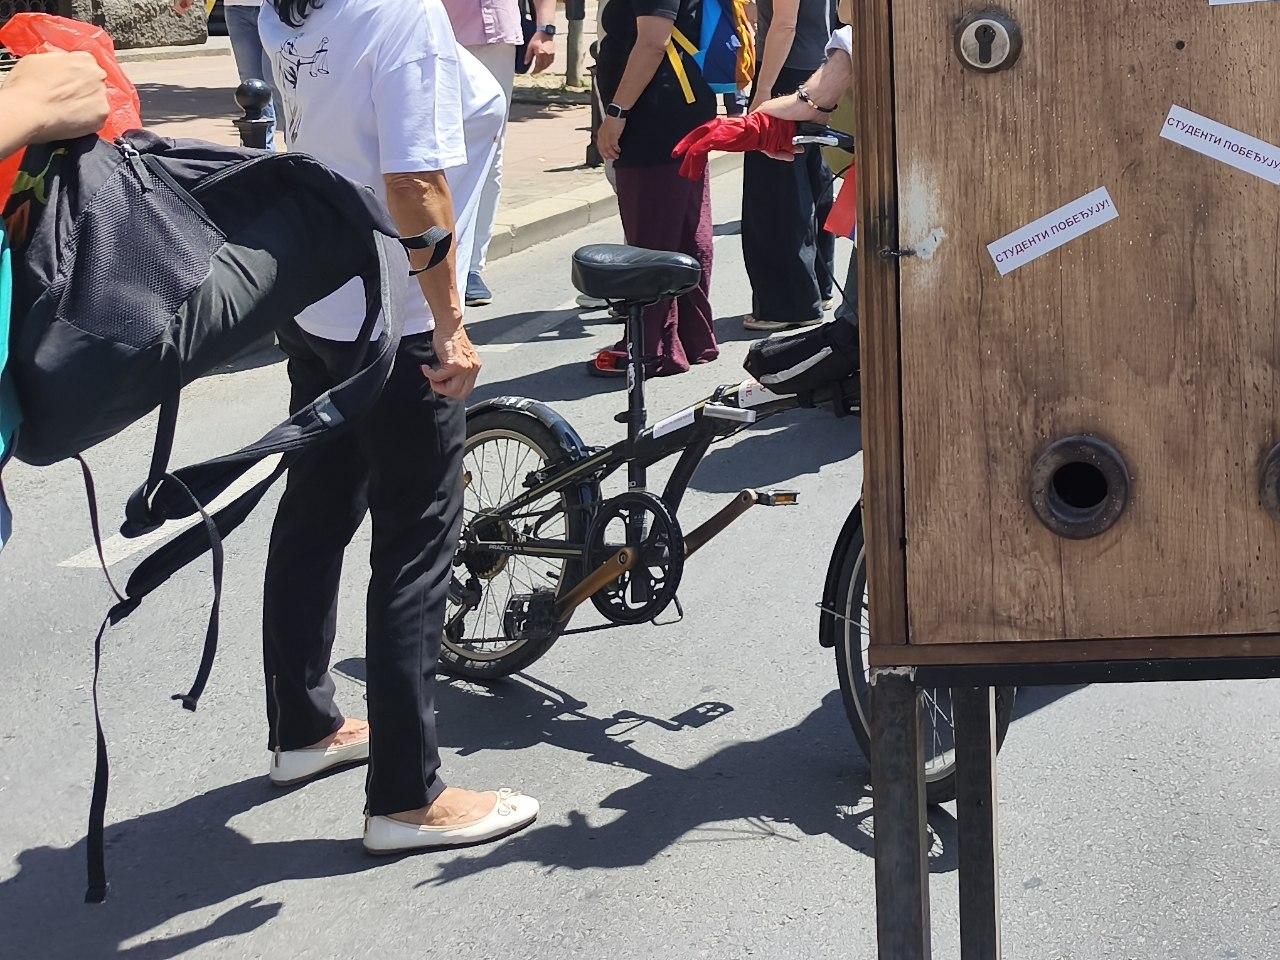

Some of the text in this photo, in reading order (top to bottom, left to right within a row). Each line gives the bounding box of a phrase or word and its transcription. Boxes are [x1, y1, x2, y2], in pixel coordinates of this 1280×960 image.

[1167, 117, 1222, 145] СТУДЕНТИ
[995, 199, 1110, 263] СТУДЕНТИ ПОБЕЂУЈУ!
